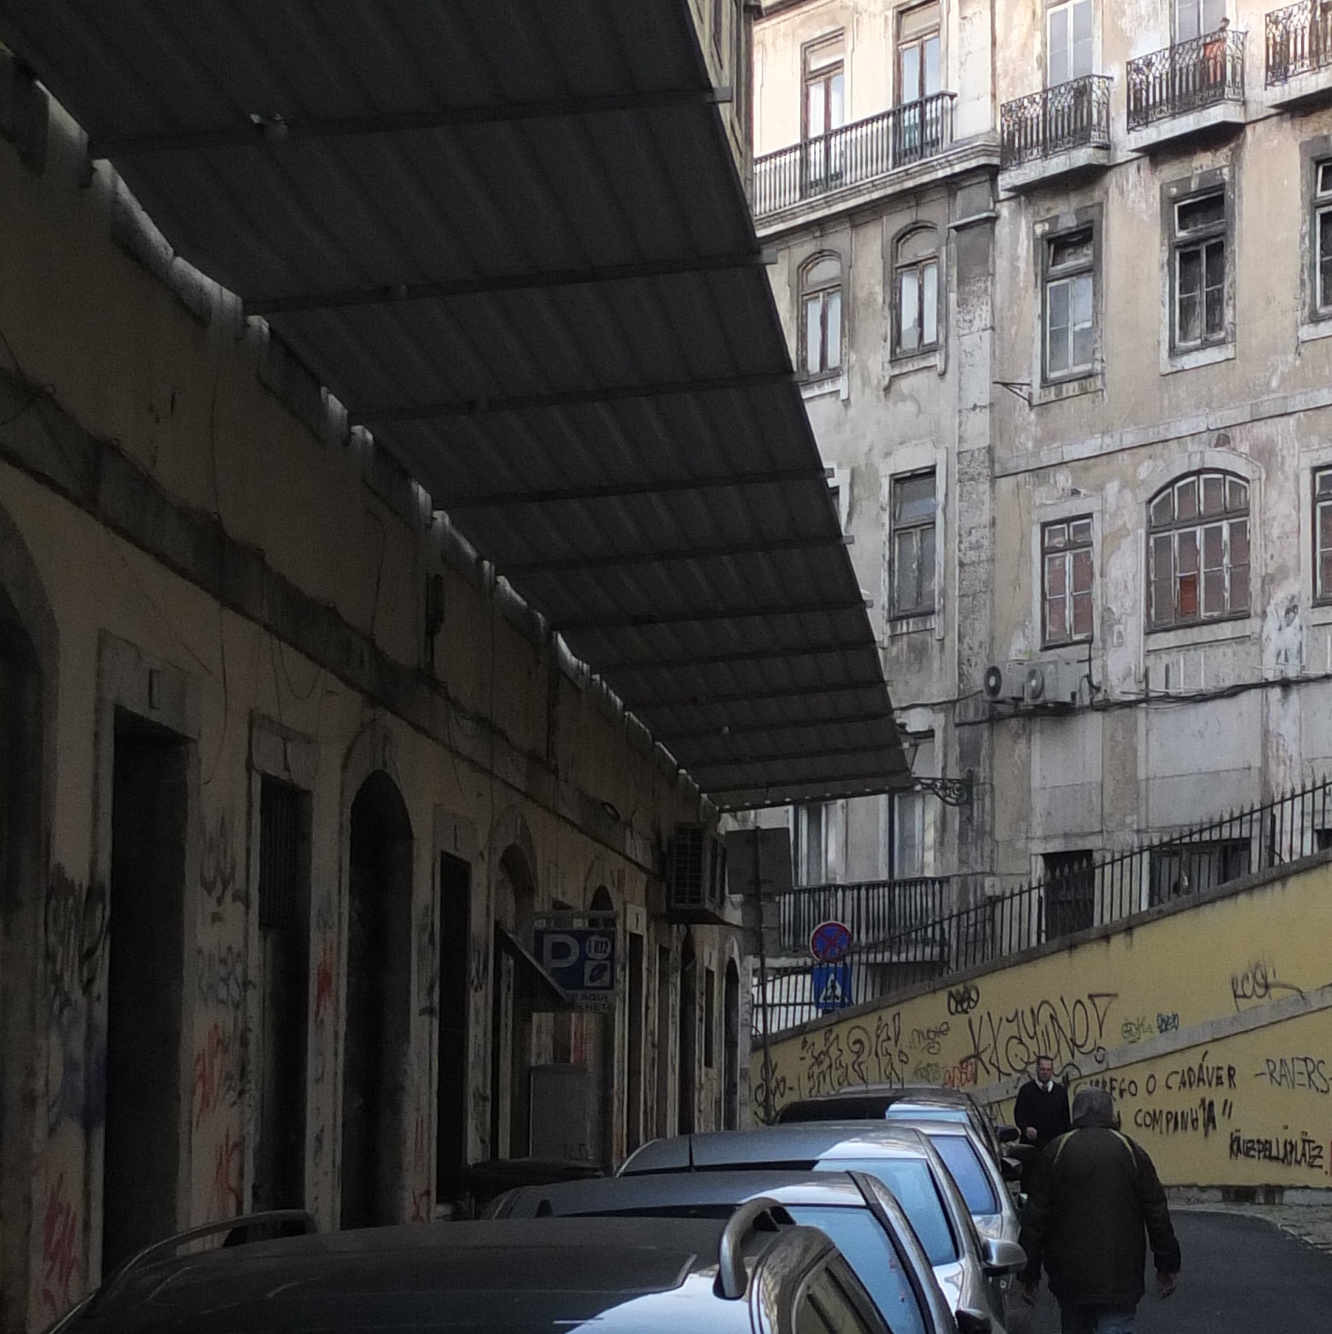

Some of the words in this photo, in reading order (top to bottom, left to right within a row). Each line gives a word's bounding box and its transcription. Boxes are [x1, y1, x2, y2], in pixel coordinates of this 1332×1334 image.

[543, 934, 579, 971] P
[1146, 1074, 1156, 1095] O
[1165, 1050, 1236, 1090] CADÁVER
